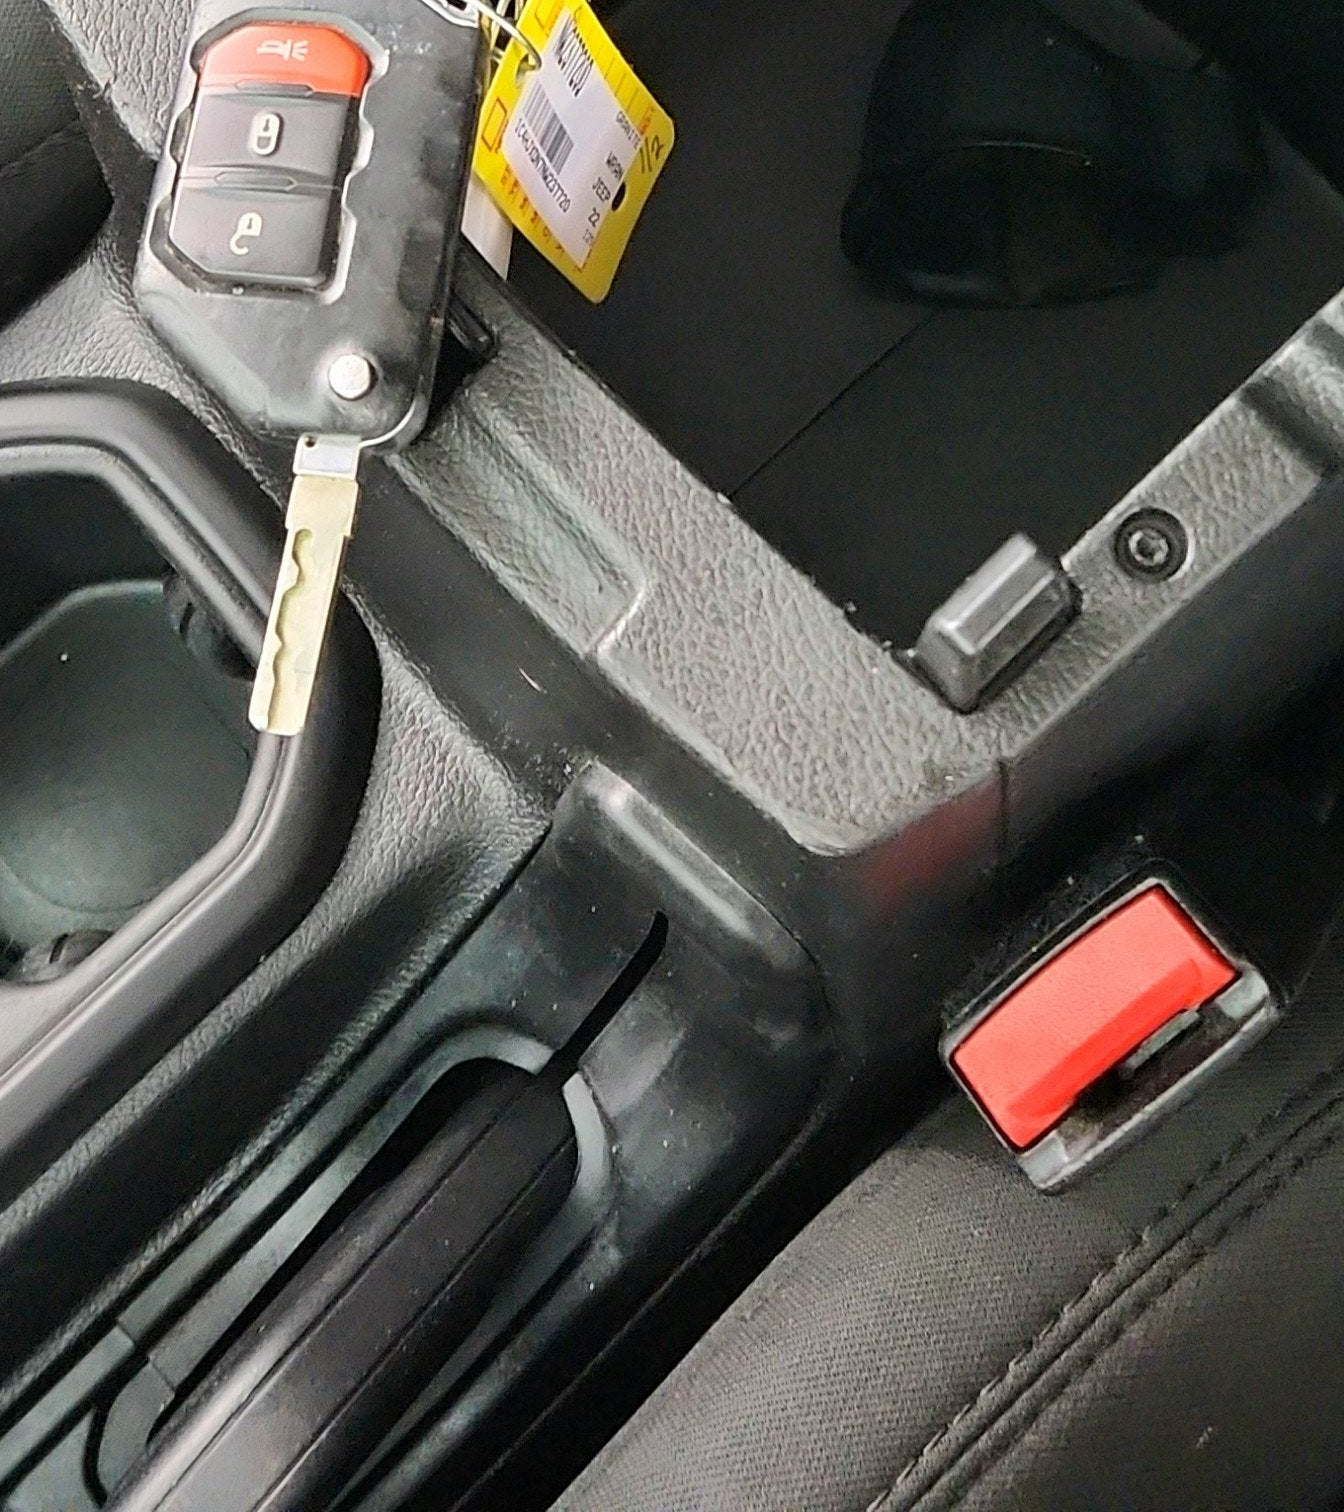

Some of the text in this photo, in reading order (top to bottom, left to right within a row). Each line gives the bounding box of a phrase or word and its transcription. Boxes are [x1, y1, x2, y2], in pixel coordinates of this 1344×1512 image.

[616, 111, 641, 150] GRANITE
[592, 177, 610, 202] JEEP
[588, 207, 600, 227] 22
